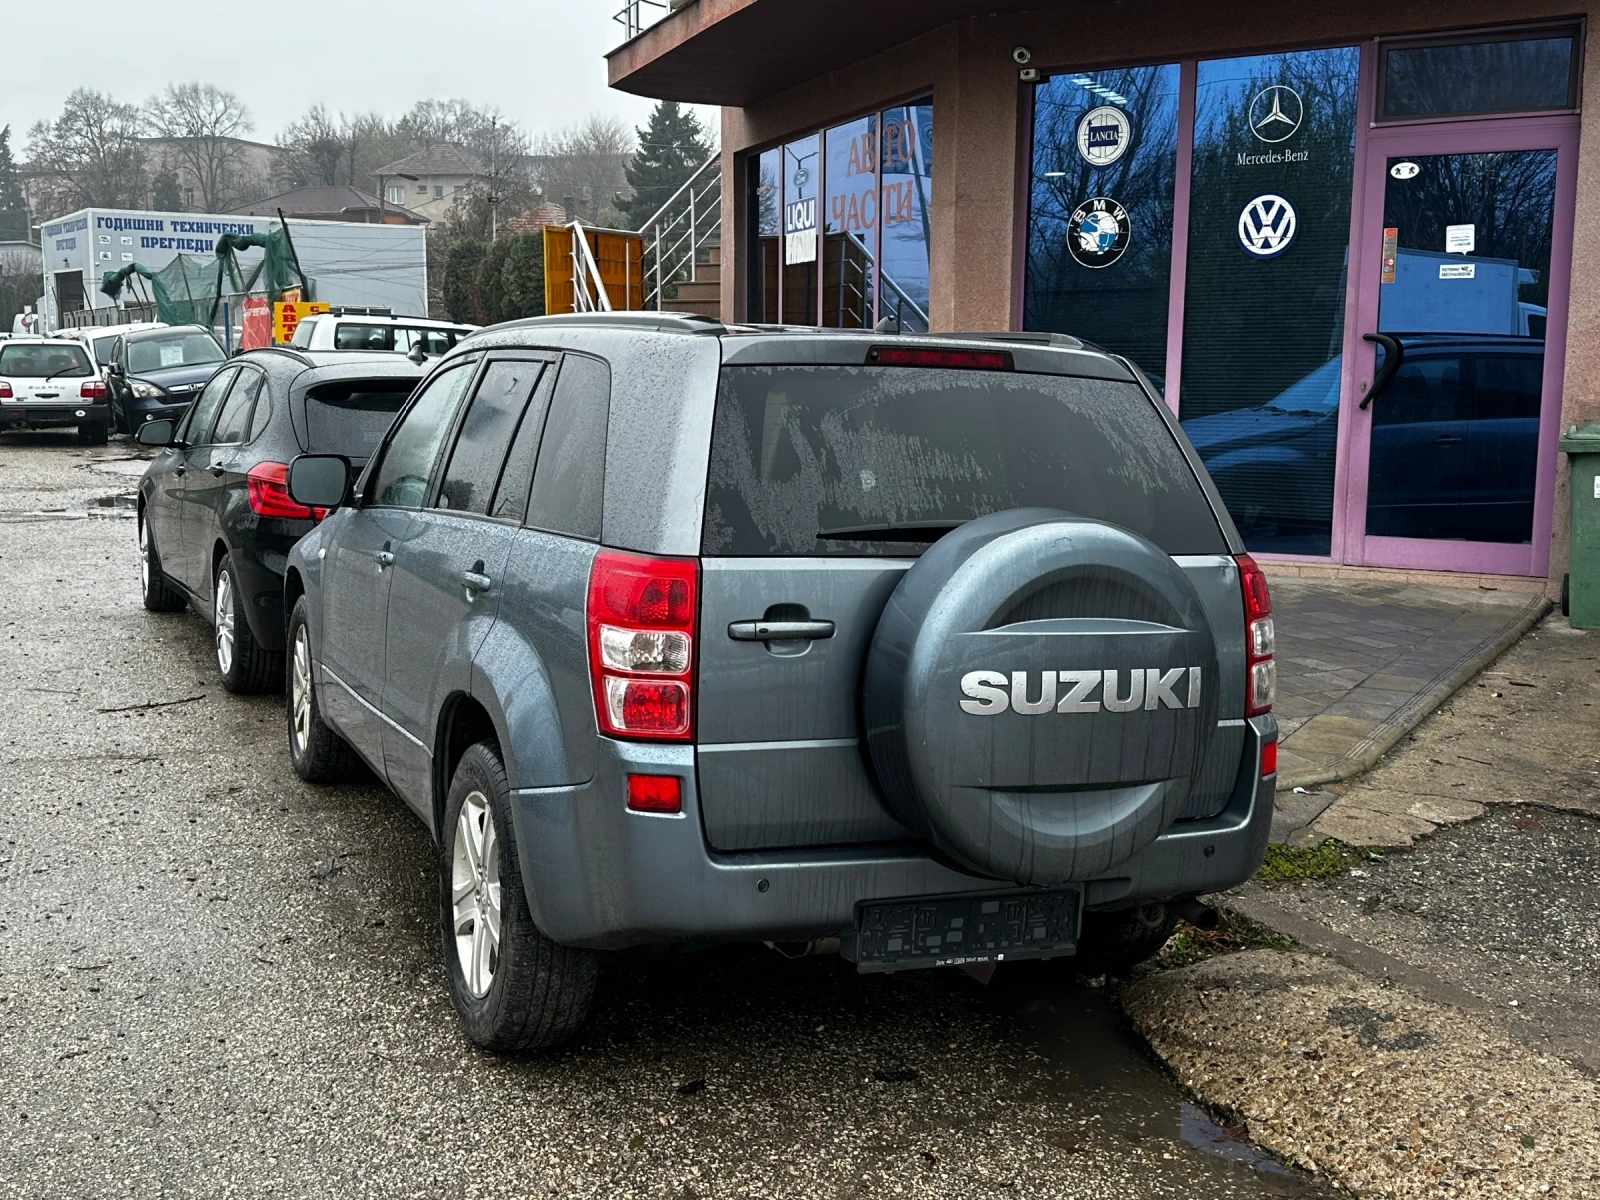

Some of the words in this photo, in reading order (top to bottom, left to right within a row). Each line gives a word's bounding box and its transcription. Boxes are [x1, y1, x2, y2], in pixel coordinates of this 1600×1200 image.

[847, 119, 915, 177] АВТО
[1089, 130, 1119, 142] LANCIA
[1237, 149, 1309, 166] Mercedes-Benz
[787, 199, 816, 232] LIQUI
[832, 179, 914, 232] ЧАСТИ
[1074, 199, 1126, 224] BMW
[97, 216, 164, 232] ГОДИШНИ
[171, 220, 254, 235] ТЕХНИЧЕСКИ
[140, 236, 214, 252] ПРЕГЛЕДИ
[959, 666, 1201, 716] SUZUKI
